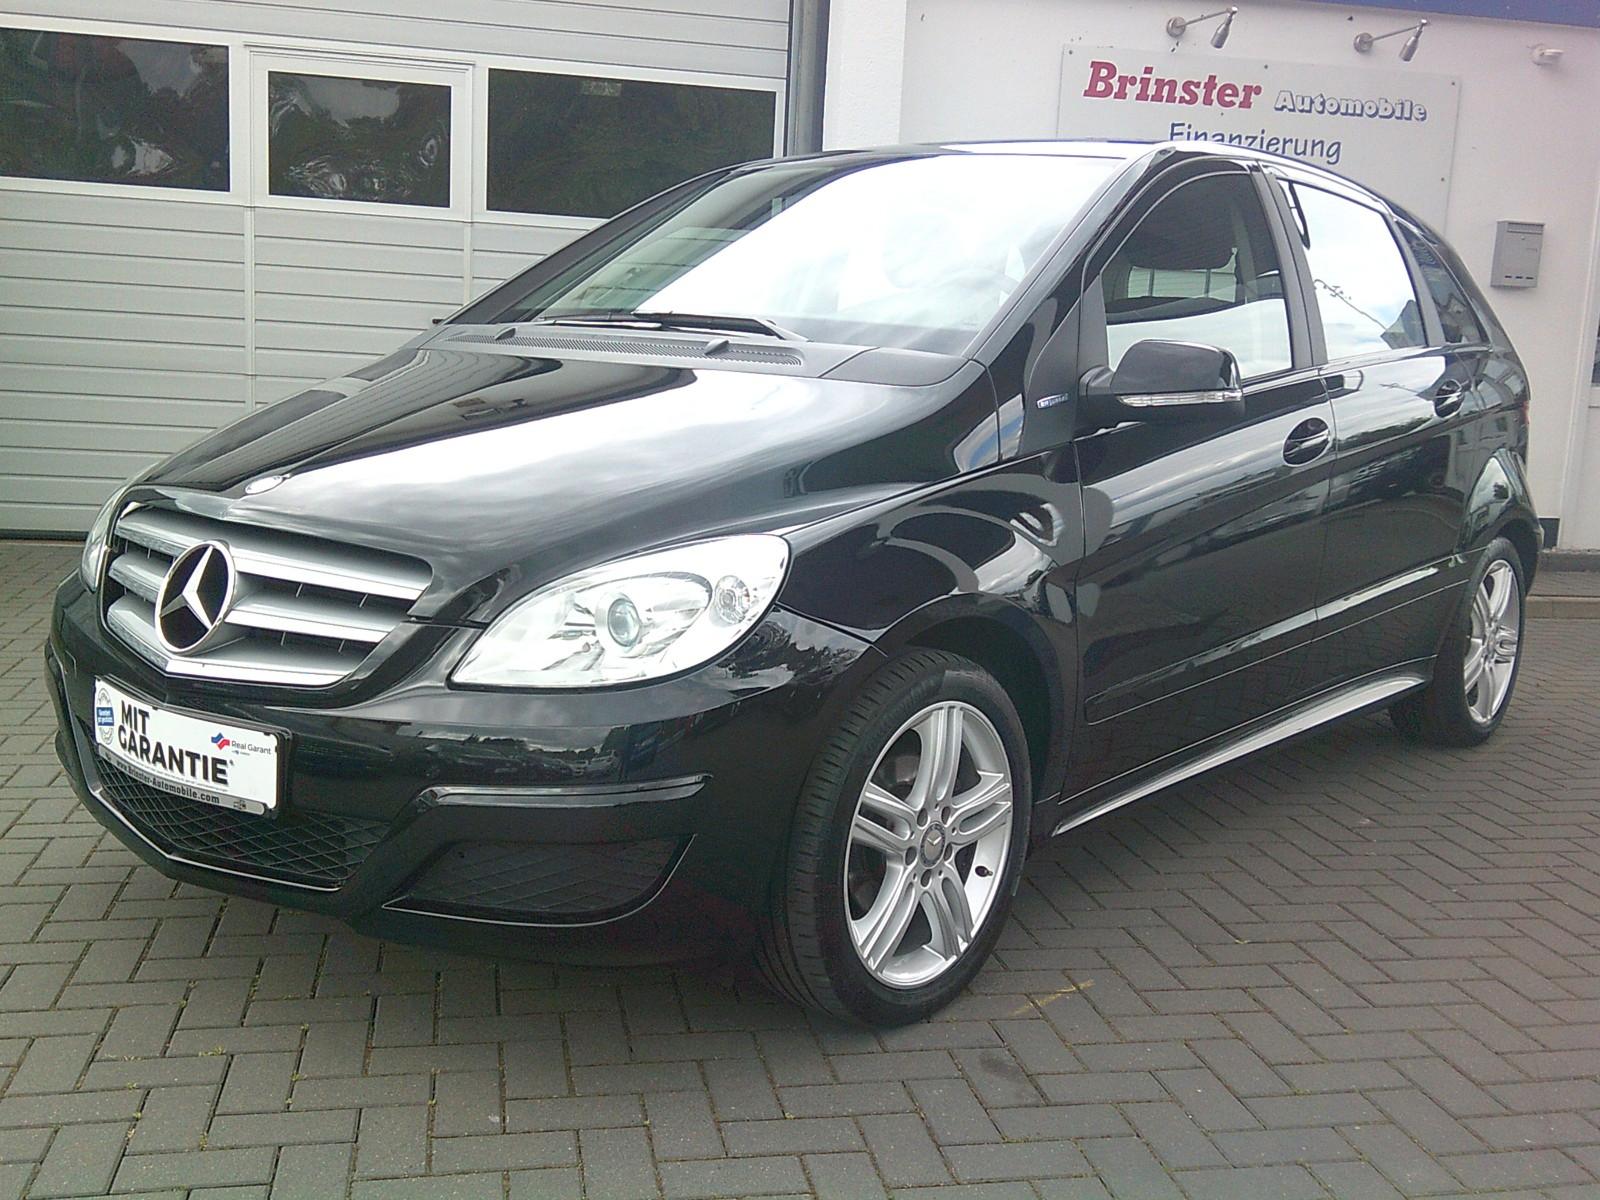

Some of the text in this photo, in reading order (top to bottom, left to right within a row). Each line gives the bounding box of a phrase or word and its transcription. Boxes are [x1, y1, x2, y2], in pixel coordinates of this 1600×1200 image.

[1082, 60, 1428, 122] Brinster Automobile
[1169, 122, 1342, 166] Finanzierung
[121, 699, 150, 736] MIT
[231, 740, 247, 751] Real
[247, 743, 272, 756] Garant
